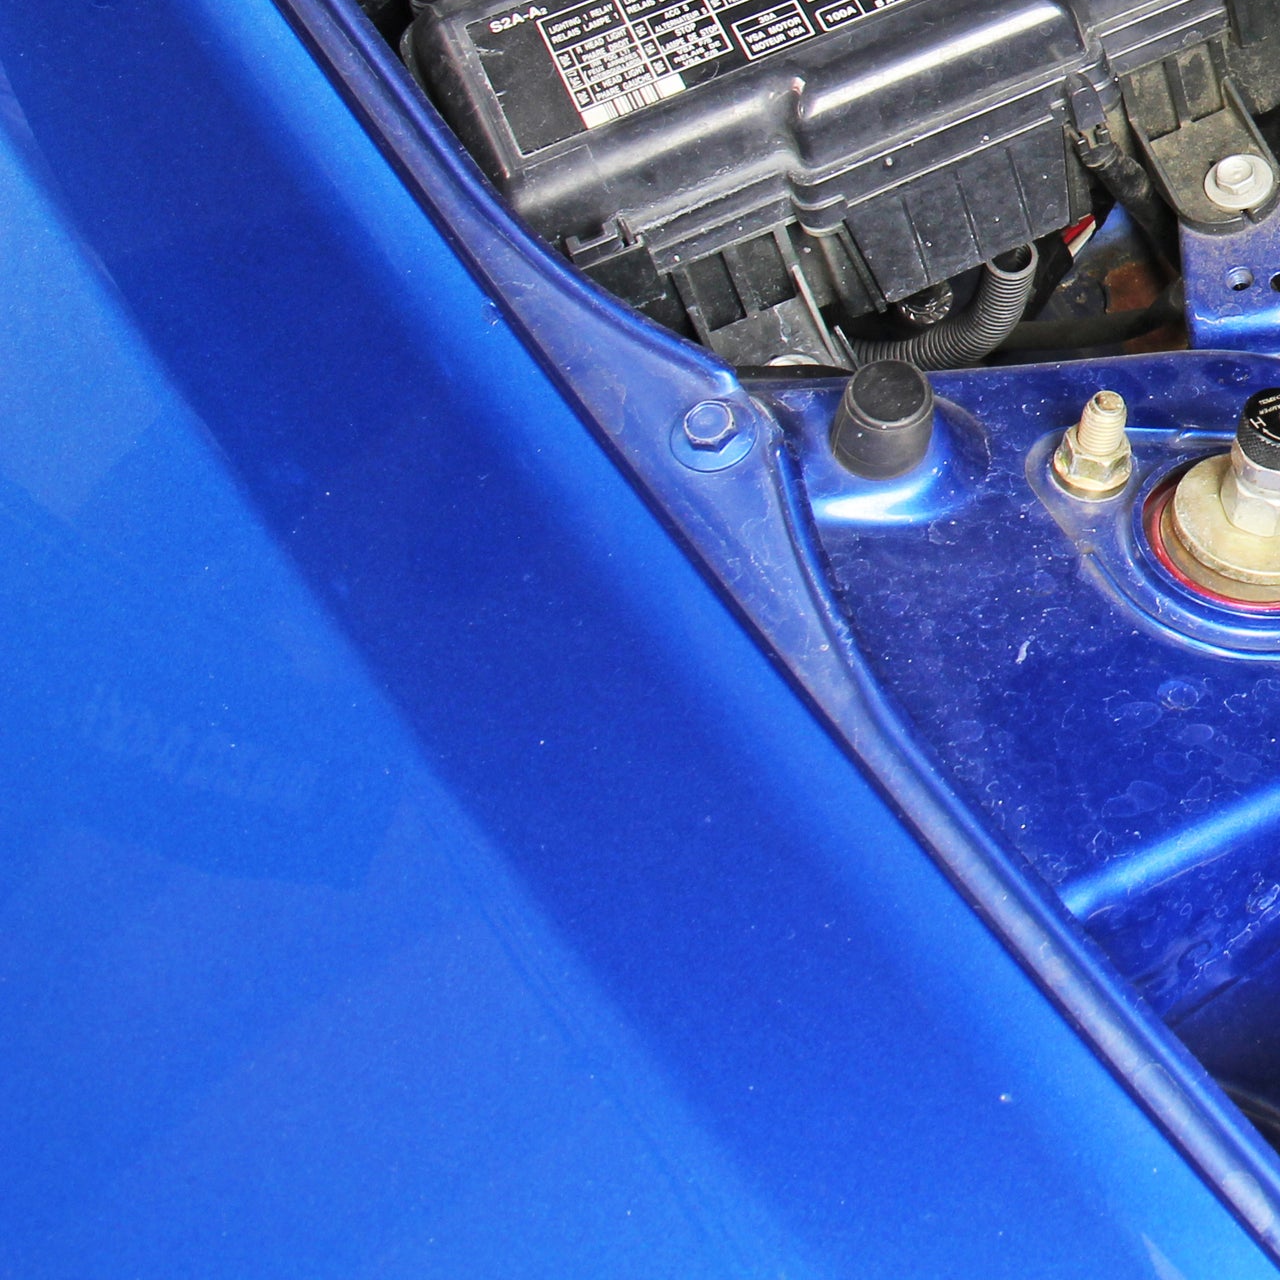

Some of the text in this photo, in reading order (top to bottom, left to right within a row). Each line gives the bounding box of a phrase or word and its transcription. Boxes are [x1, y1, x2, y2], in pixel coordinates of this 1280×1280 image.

[548, 3, 613, 34] LIGHTING RELAY
[664, 8, 681, 19] ACG
[826, 6, 857, 22] 100A
[551, 15, 611, 44] RELAIS LAMPE
[584, 27, 626, 50] HEAD LIGHT
[661, 24, 718, 52] LAMPE STOP
[675, 23, 696, 36] STOP
[745, 17, 801, 43] VSA MOTOR
[751, 26, 805, 52] MOTEUR VSA
[582, 38, 629, 62] PHARE DROIT
[602, 75, 622, 88] HEAD
[624, 65, 645, 79] LIGHT
[595, 85, 621, 100] PHARE
[1249, 416, 1266, 428] H
